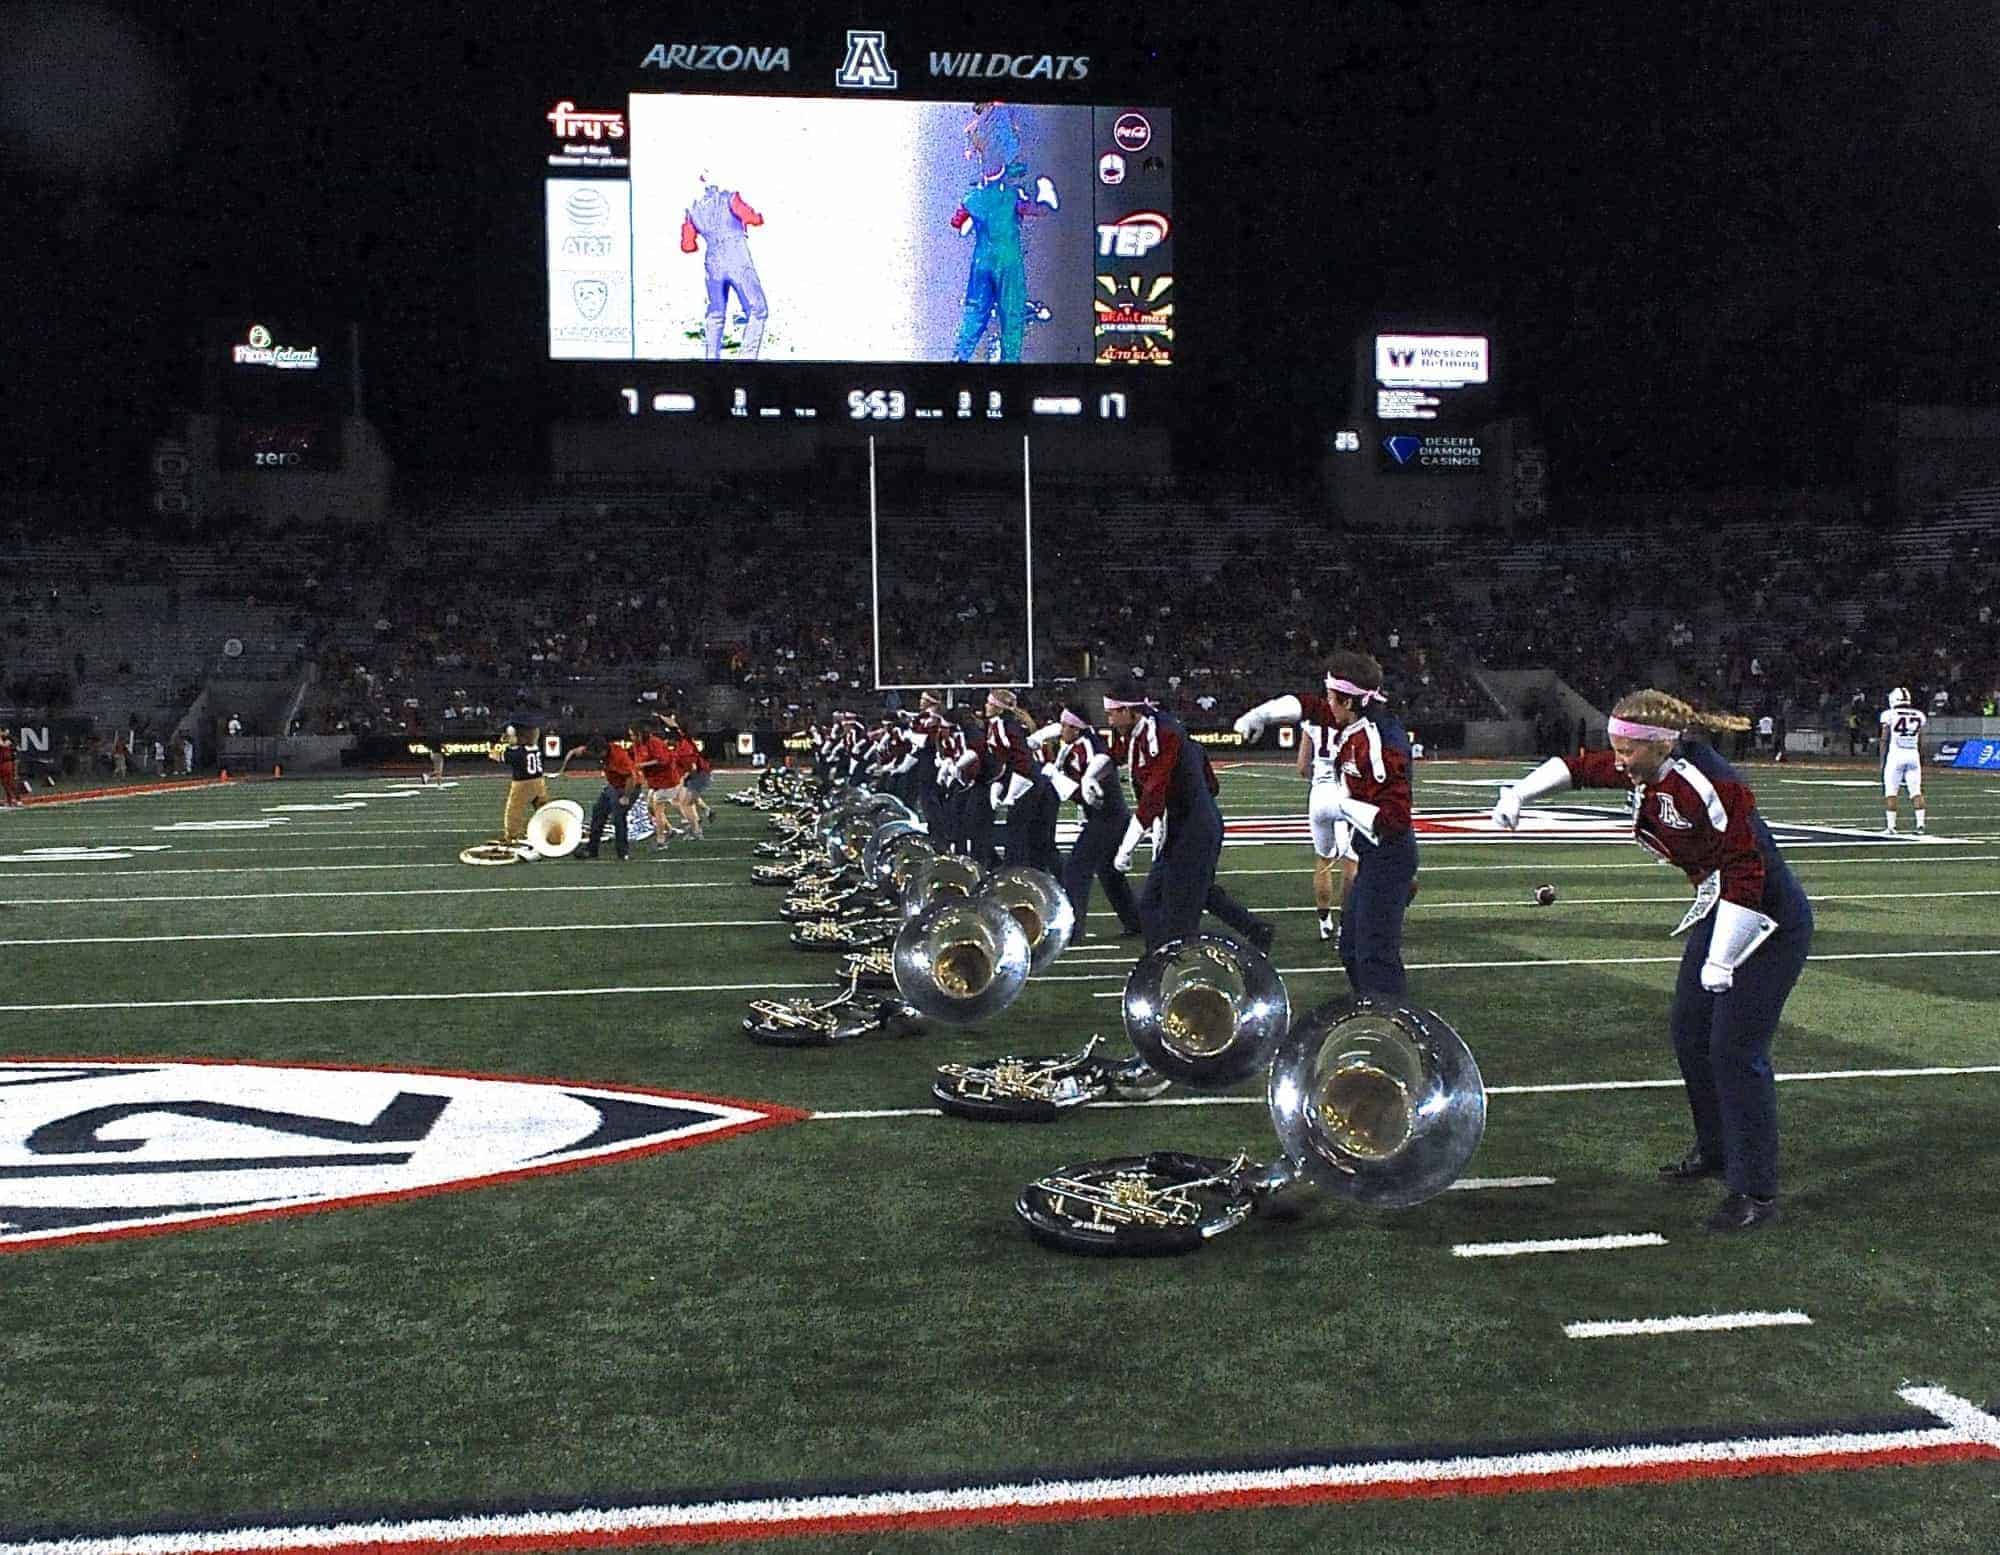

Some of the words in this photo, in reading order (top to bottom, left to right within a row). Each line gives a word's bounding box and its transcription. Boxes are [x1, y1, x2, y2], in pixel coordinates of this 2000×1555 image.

[640, 44, 790, 72] ARIZONA
[836, 31, 897, 89] A
[929, 52, 1090, 80] WILDCATS
[1097, 224, 1162, 256] TEP
[1425, 437, 1475, 446] DESERT
[255, 451, 301, 464] zero
[1419, 447, 1481, 457] DIAMOND
[1420, 456, 1480, 466] CASINOS
